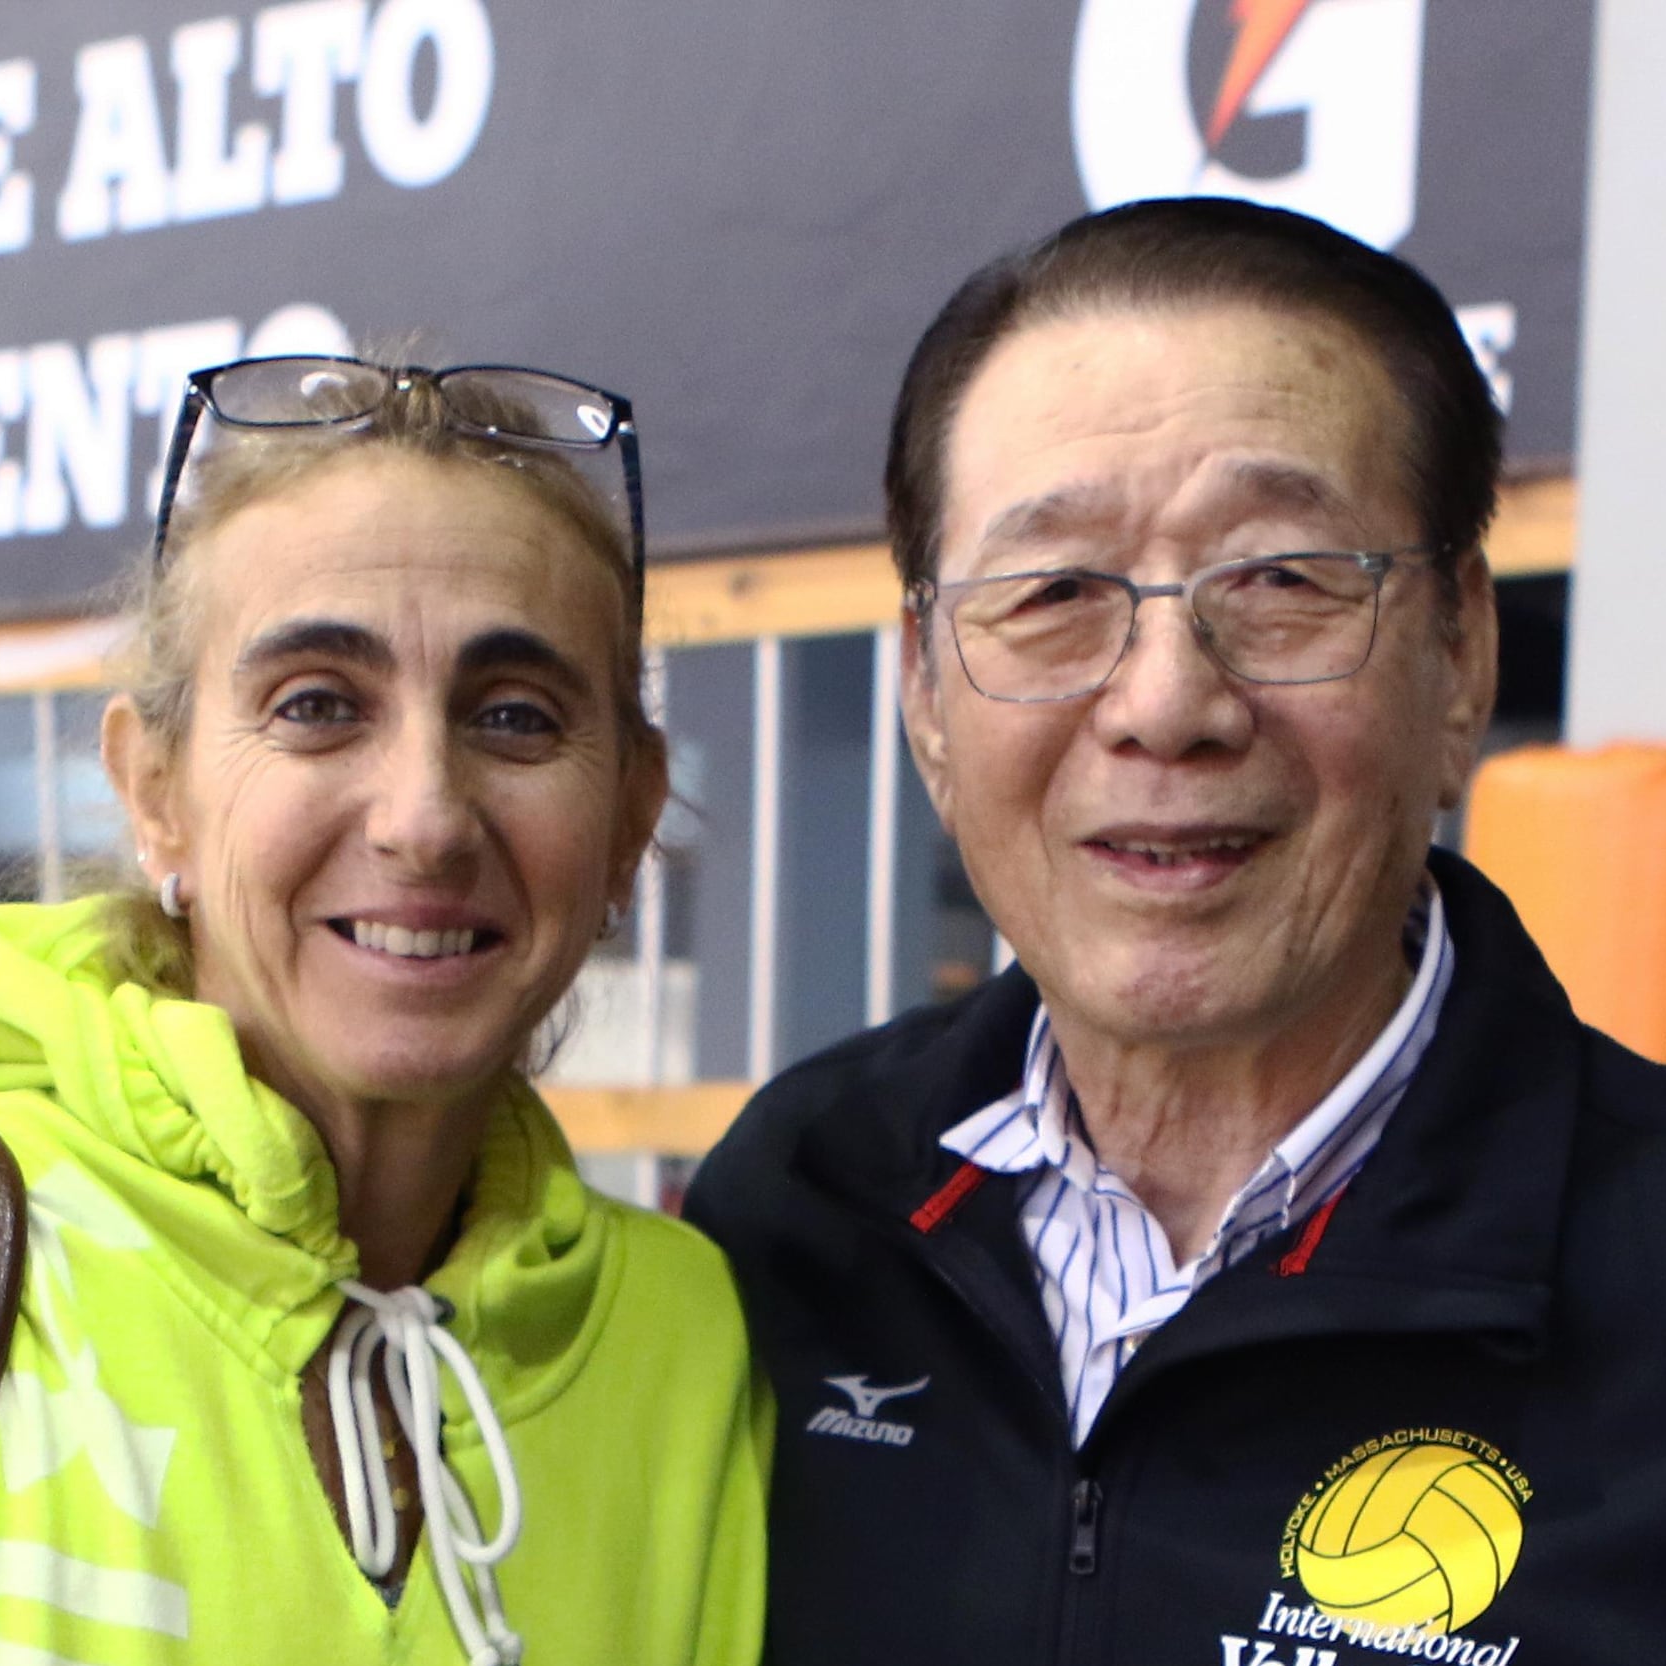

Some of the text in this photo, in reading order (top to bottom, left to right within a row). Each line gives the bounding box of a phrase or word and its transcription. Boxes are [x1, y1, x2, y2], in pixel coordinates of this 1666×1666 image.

[59, 0, 495, 242] ALTO
[1279, 1427, 1534, 1579] HOLYOKE MASSACHUSETTS USA
